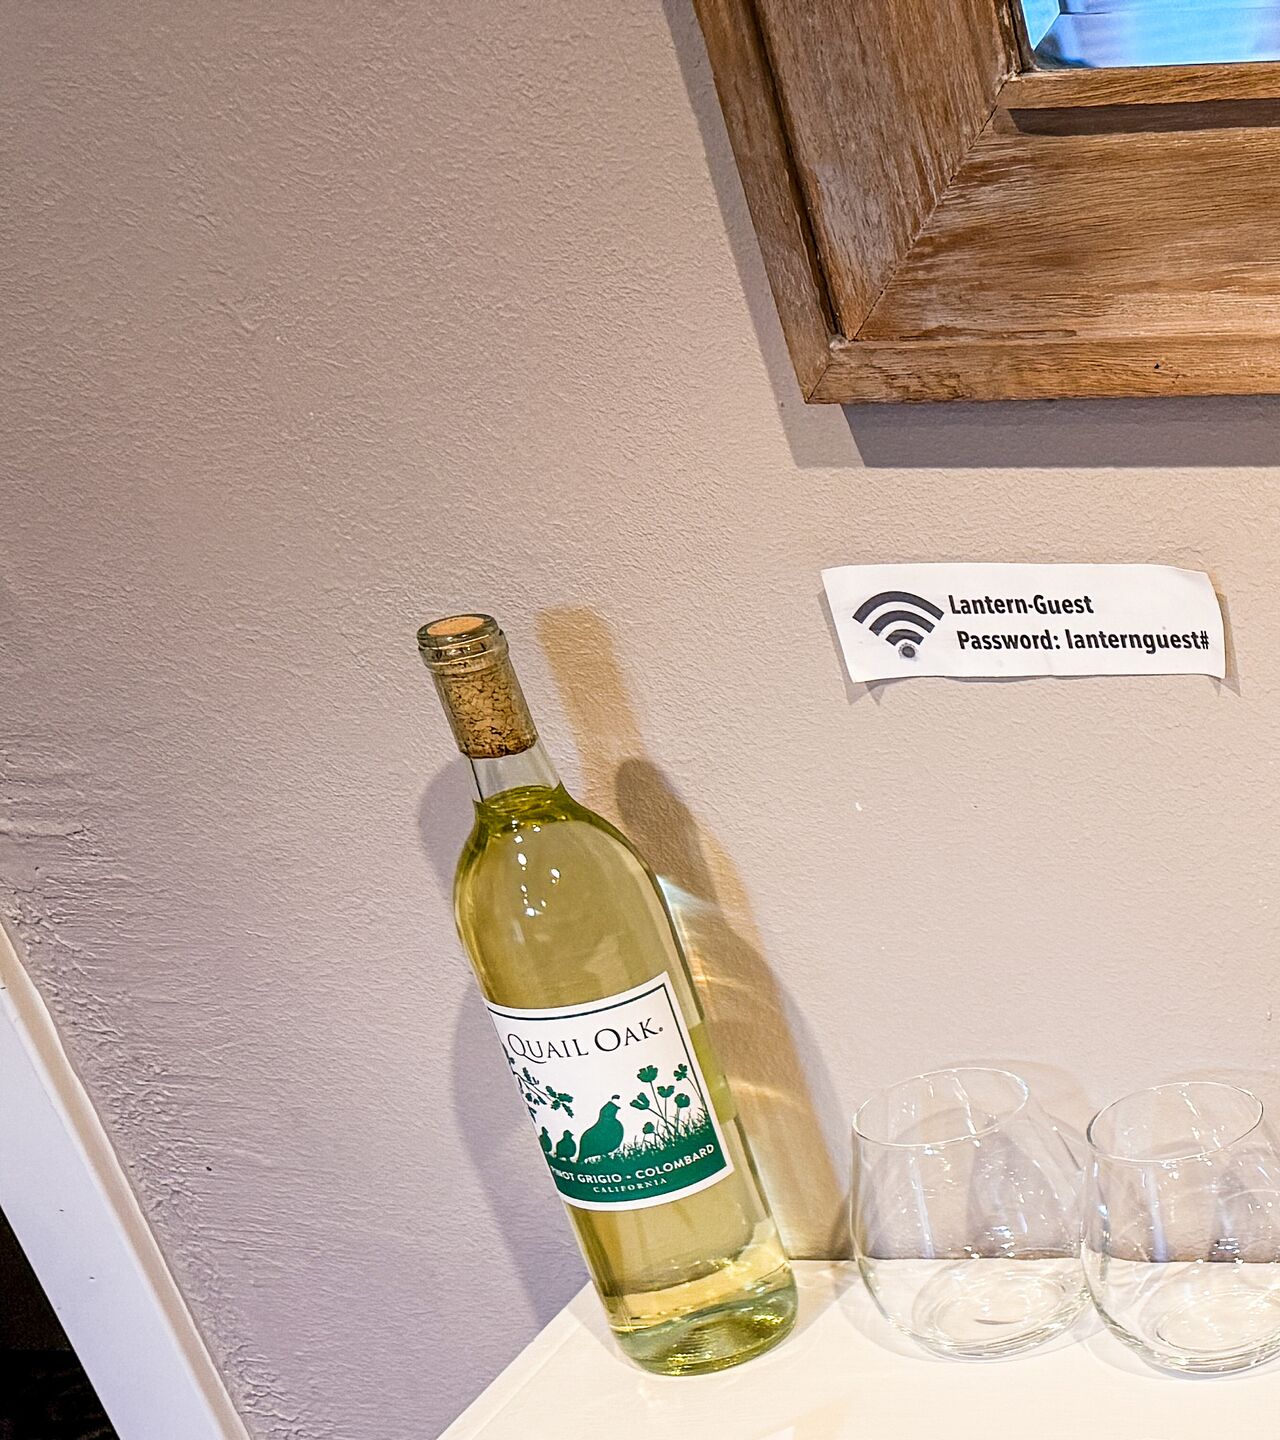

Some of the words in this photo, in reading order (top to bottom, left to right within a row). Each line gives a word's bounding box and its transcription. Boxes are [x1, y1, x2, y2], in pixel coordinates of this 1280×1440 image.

[948, 594, 1094, 615] Lantern-Guest
[957, 630, 1060, 651] Password:
[1065, 629, 1210, 654] lanternguest#
[507, 1033, 589, 1064] QUAIL
[577, 1174, 622, 1184] GRIGIO
[635, 1143, 714, 1179] COLOMBARD
[593, 1177, 668, 1193] CALIFORNIA
